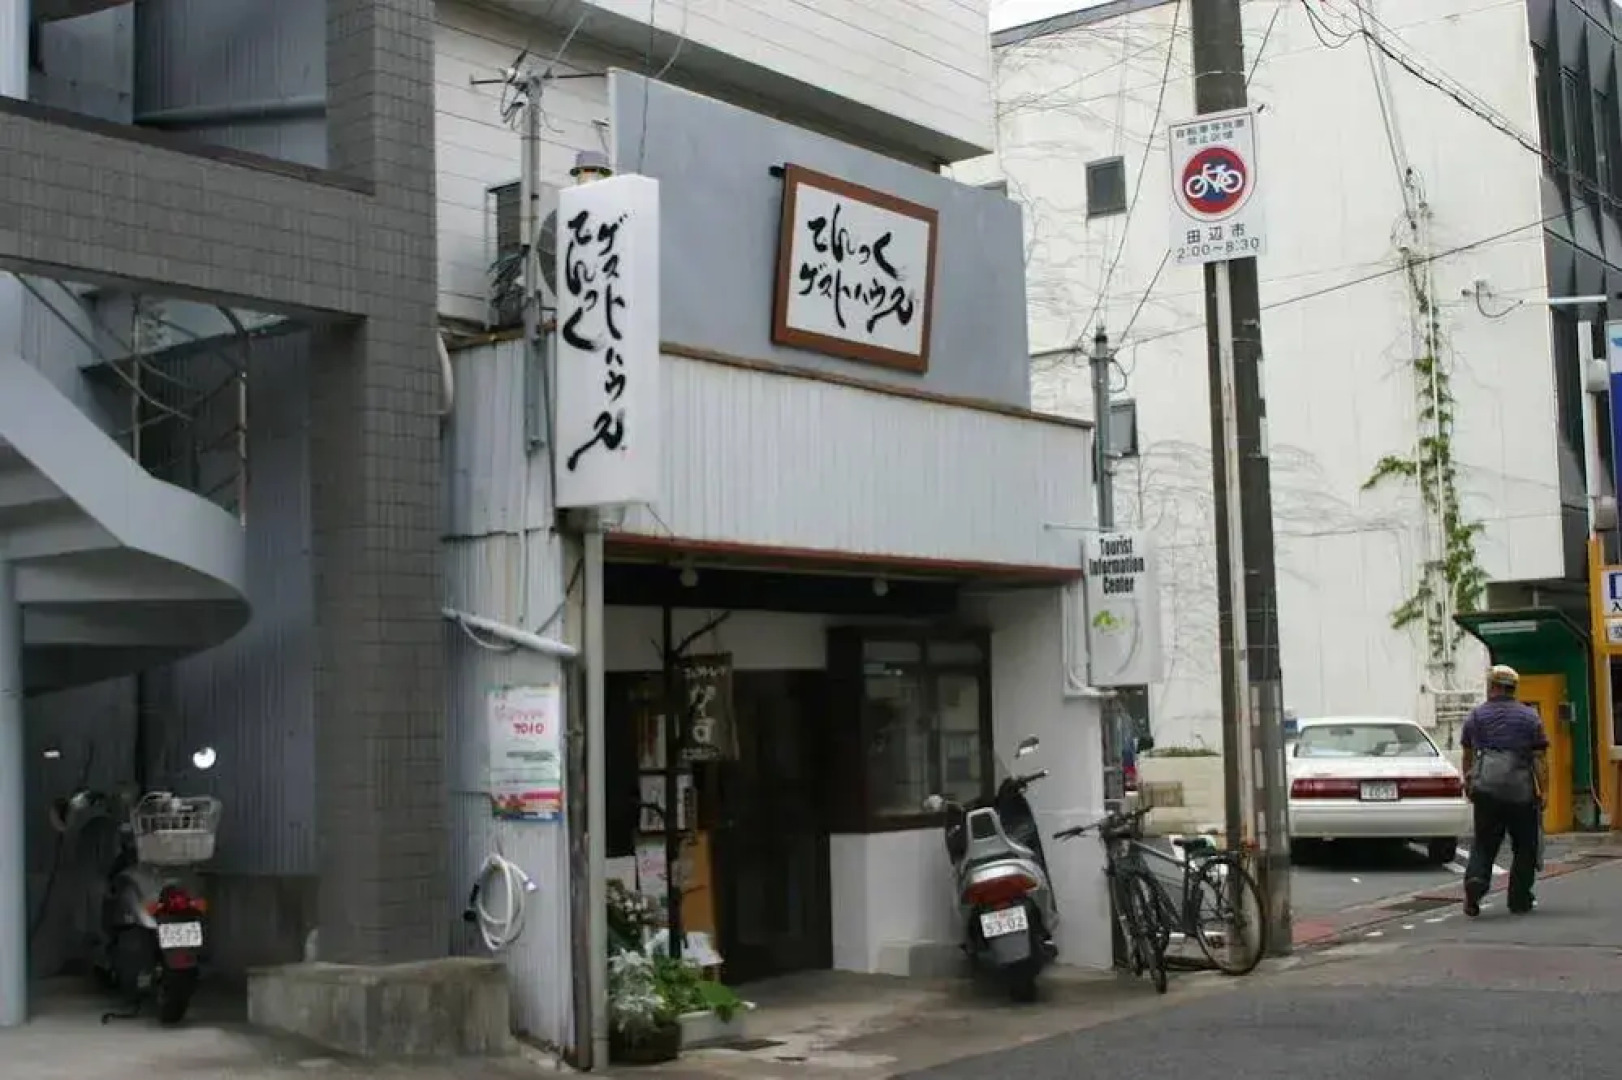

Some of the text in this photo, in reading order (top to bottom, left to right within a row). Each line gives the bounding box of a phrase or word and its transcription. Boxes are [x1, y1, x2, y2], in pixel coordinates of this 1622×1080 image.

[799, 262, 915, 334] ゲストハウス
[565, 210, 627, 472] ゲストハウス
[1099, 535, 1133, 556] Tourist
[1088, 557, 1144, 576] Information
[1103, 576, 1135, 595] Center
